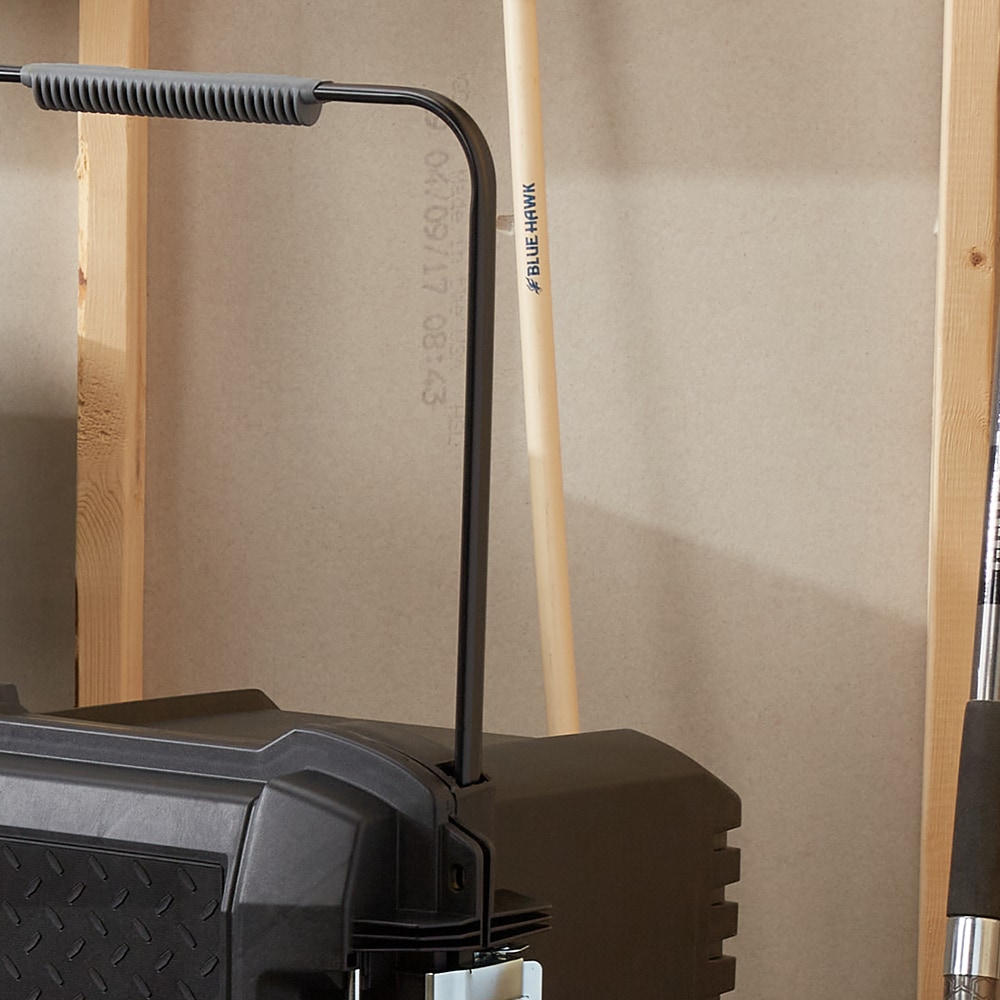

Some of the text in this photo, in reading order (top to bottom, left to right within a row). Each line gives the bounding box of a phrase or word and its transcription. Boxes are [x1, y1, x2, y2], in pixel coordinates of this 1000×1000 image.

[424, 151, 448, 294] 04/09/17
[523, 182, 540, 277] BLUE HAWK
[422, 314, 447, 405] 08:43
